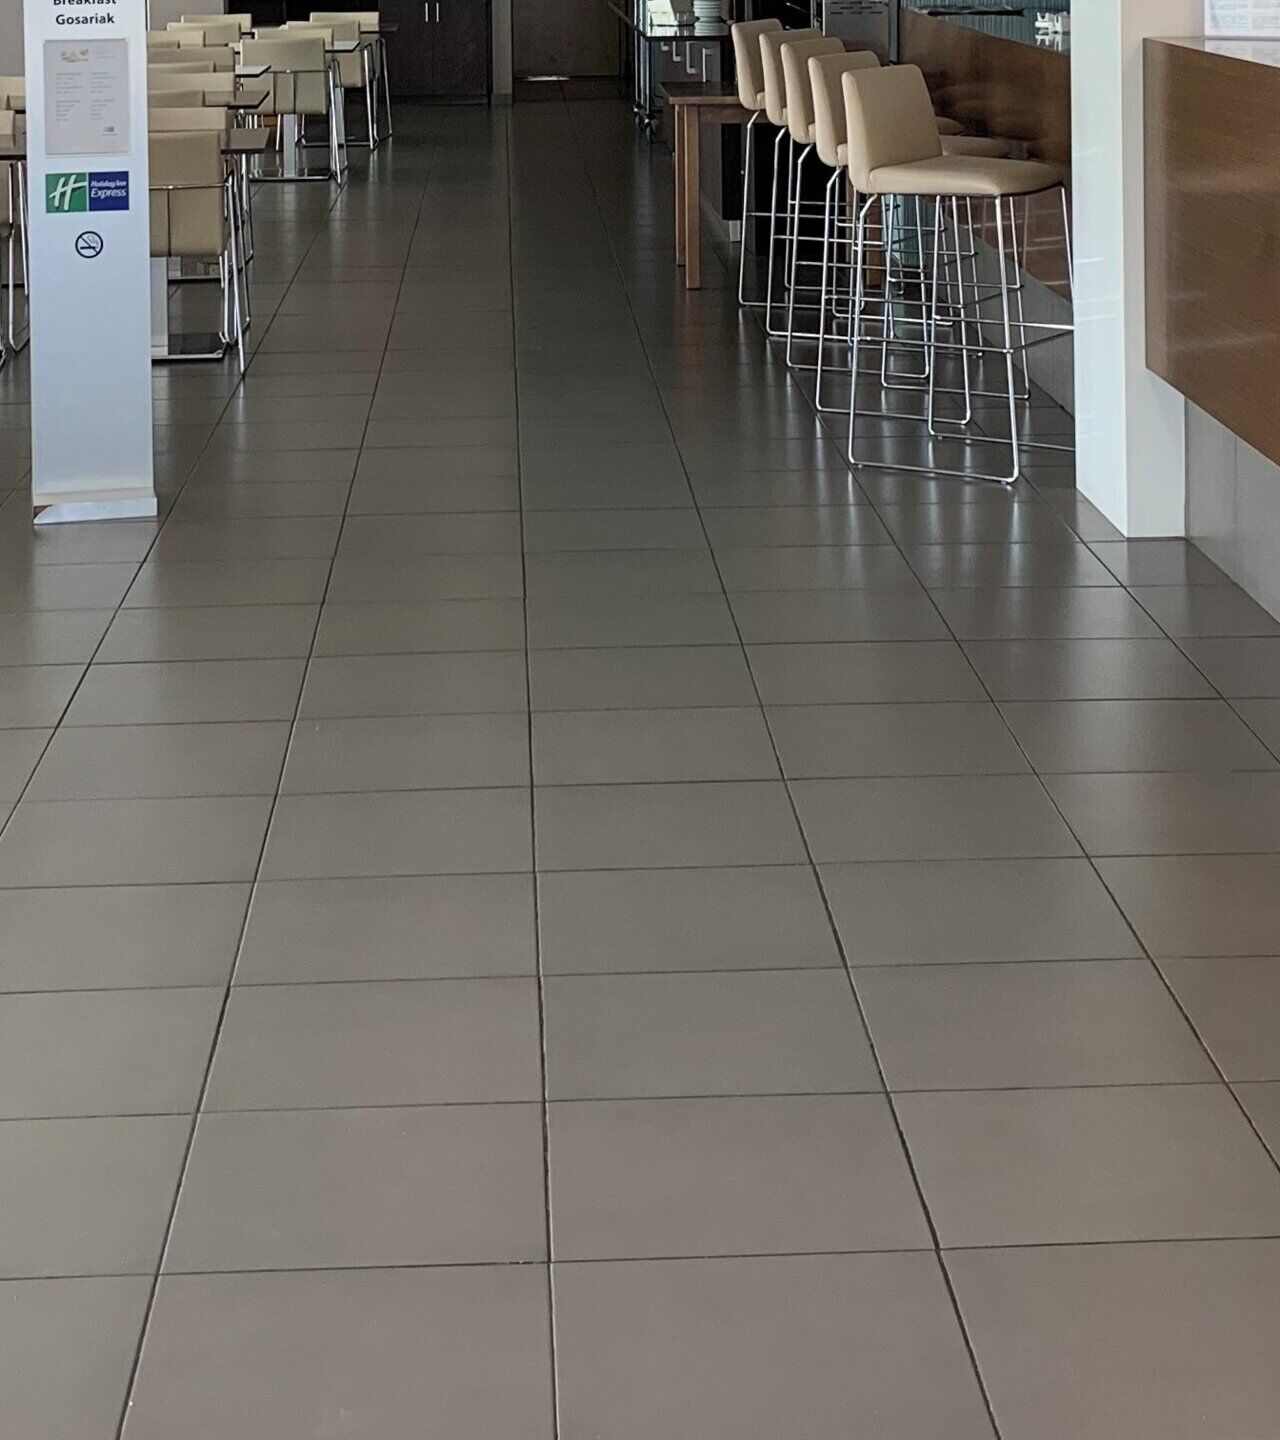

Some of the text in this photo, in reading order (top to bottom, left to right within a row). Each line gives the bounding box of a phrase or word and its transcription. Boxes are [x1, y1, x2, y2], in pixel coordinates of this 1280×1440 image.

[55, 13, 115, 25] Gosariak
[91, 180, 116, 188] Holiday
[91, 188, 127, 200] Express
